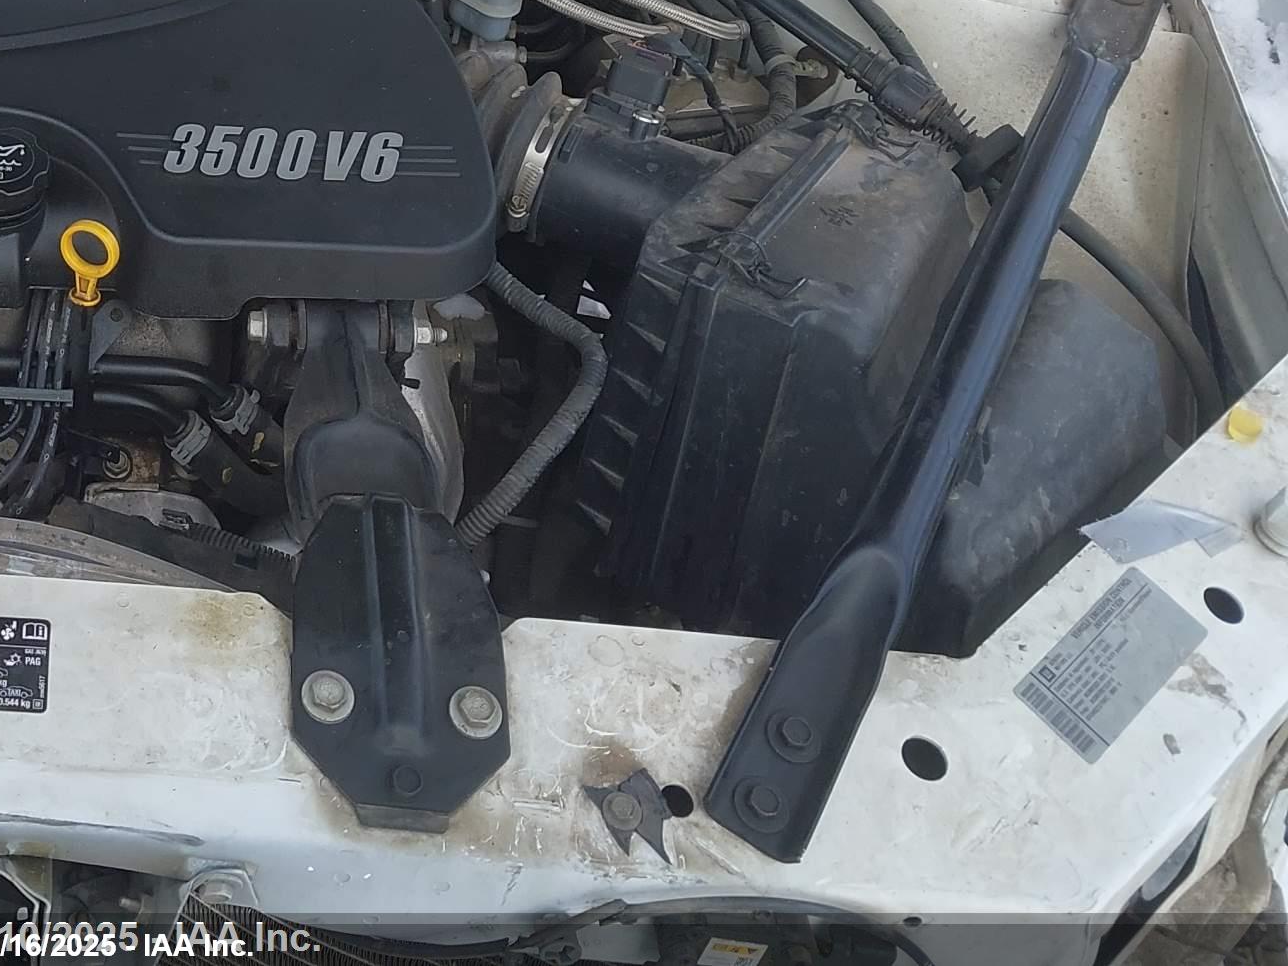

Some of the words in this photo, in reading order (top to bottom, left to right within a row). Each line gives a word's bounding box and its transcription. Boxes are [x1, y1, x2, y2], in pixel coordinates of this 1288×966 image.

[163, 122, 317, 180] 3500
[323, 130, 404, 183] V6
[25, 656, 41, 666] PAG
[20, 698, 31, 709] kg
